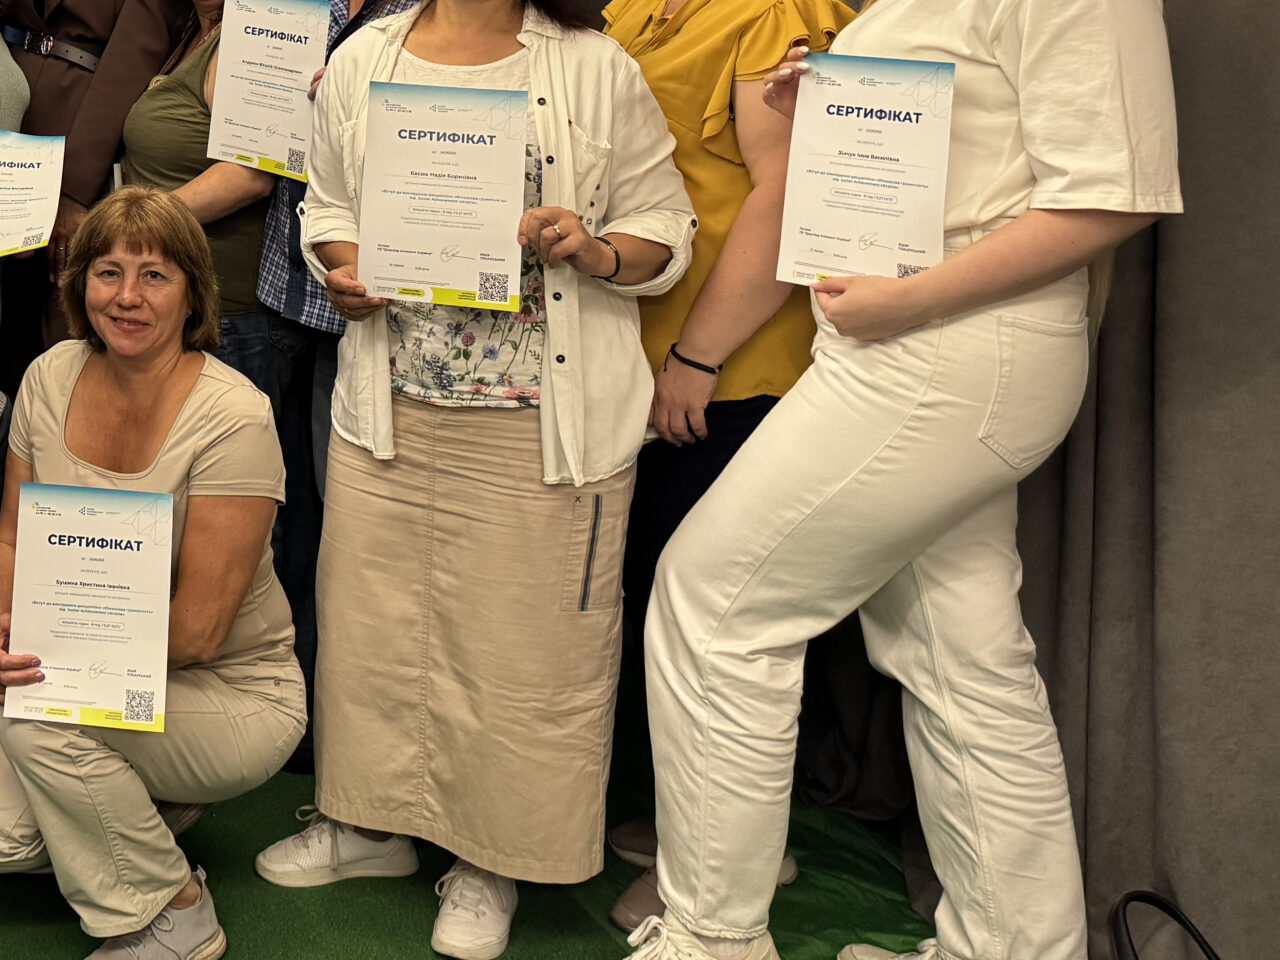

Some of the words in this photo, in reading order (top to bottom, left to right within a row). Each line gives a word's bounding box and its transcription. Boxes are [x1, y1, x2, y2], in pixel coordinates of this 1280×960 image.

[244, 25, 310, 45] СЕРТИФІКАТ
[826, 104, 923, 124] СЕРТИФІКАТ
[397, 128, 497, 146] СЕРТИФІКАТ
[47, 533, 144, 552] СЕРТИФІКАТ
